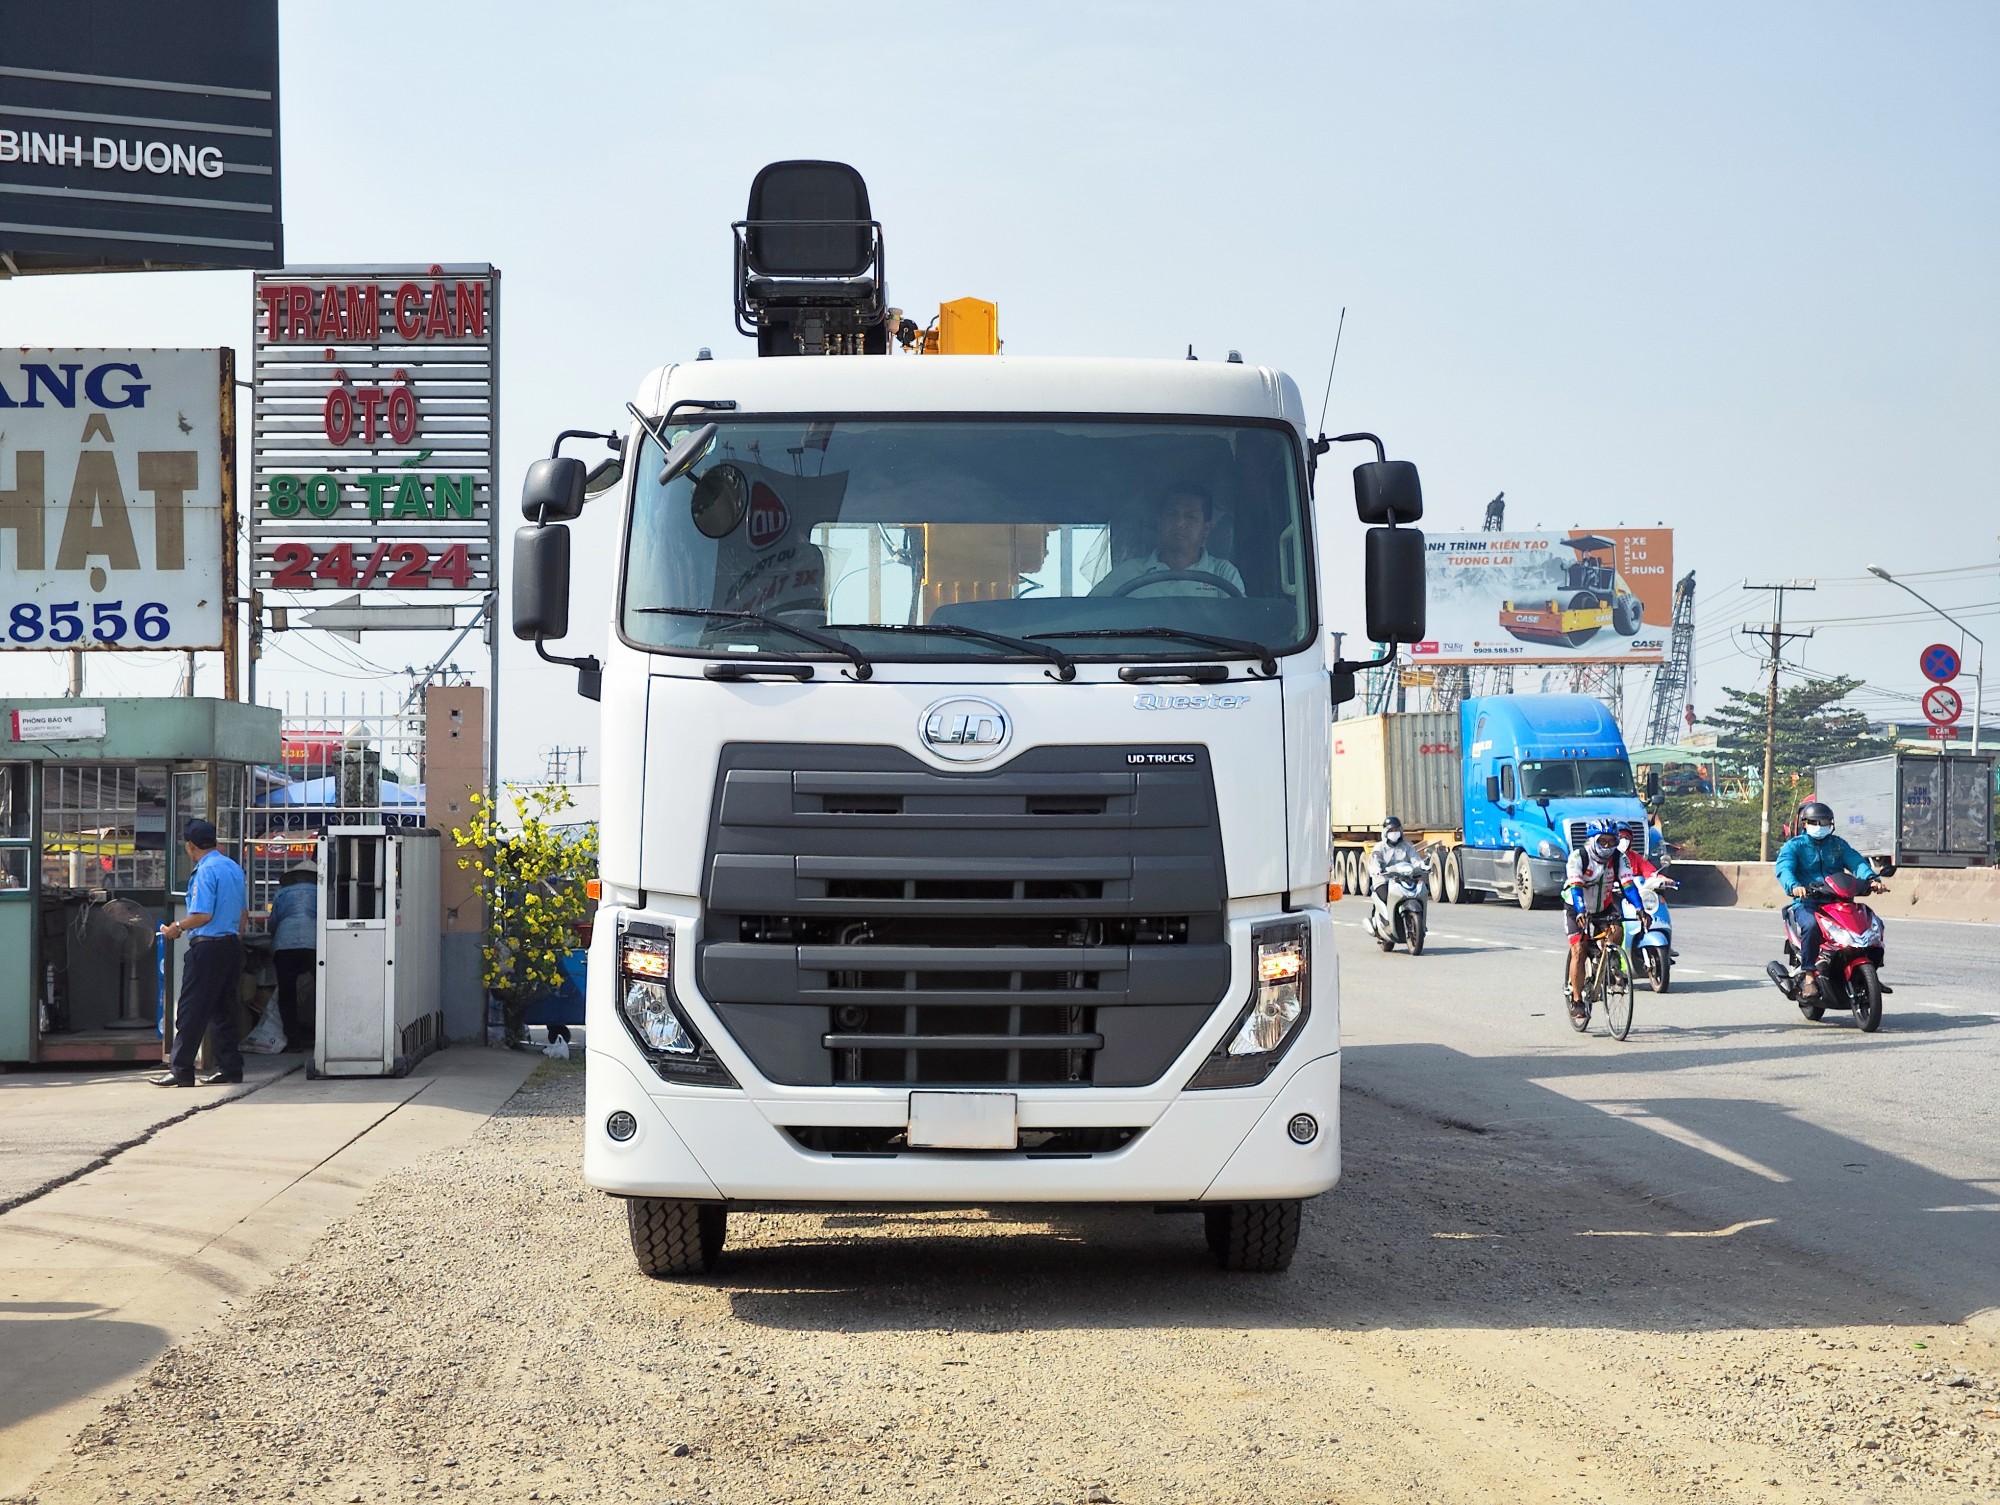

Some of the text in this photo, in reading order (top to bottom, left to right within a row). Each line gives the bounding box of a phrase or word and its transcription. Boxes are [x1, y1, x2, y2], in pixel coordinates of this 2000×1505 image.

[0, 129, 224, 179] BINH DUONG
[394, 264, 486, 340] CÂN
[323, 368, 417, 446] ÔTÔ
[267, 450, 475, 518] 80 TẤN
[1450, 539, 1487, 551] TRÌNH
[1632, 537, 1647, 545] XE
[1493, 556, 1514, 565] LAI
[1632, 552, 1647, 560] LU
[271, 542, 474, 588] 24/24
[1632, 566, 1665, 574] RUNG
[0, 600, 171, 643] 8556
[1516, 615, 1540, 624] CASE
[1631, 640, 1664, 648] CASE
[1133, 693, 1251, 710] Quester
[928, 714, 1006, 746] UD
[1127, 754, 1195, 764] UD TRUCKS
